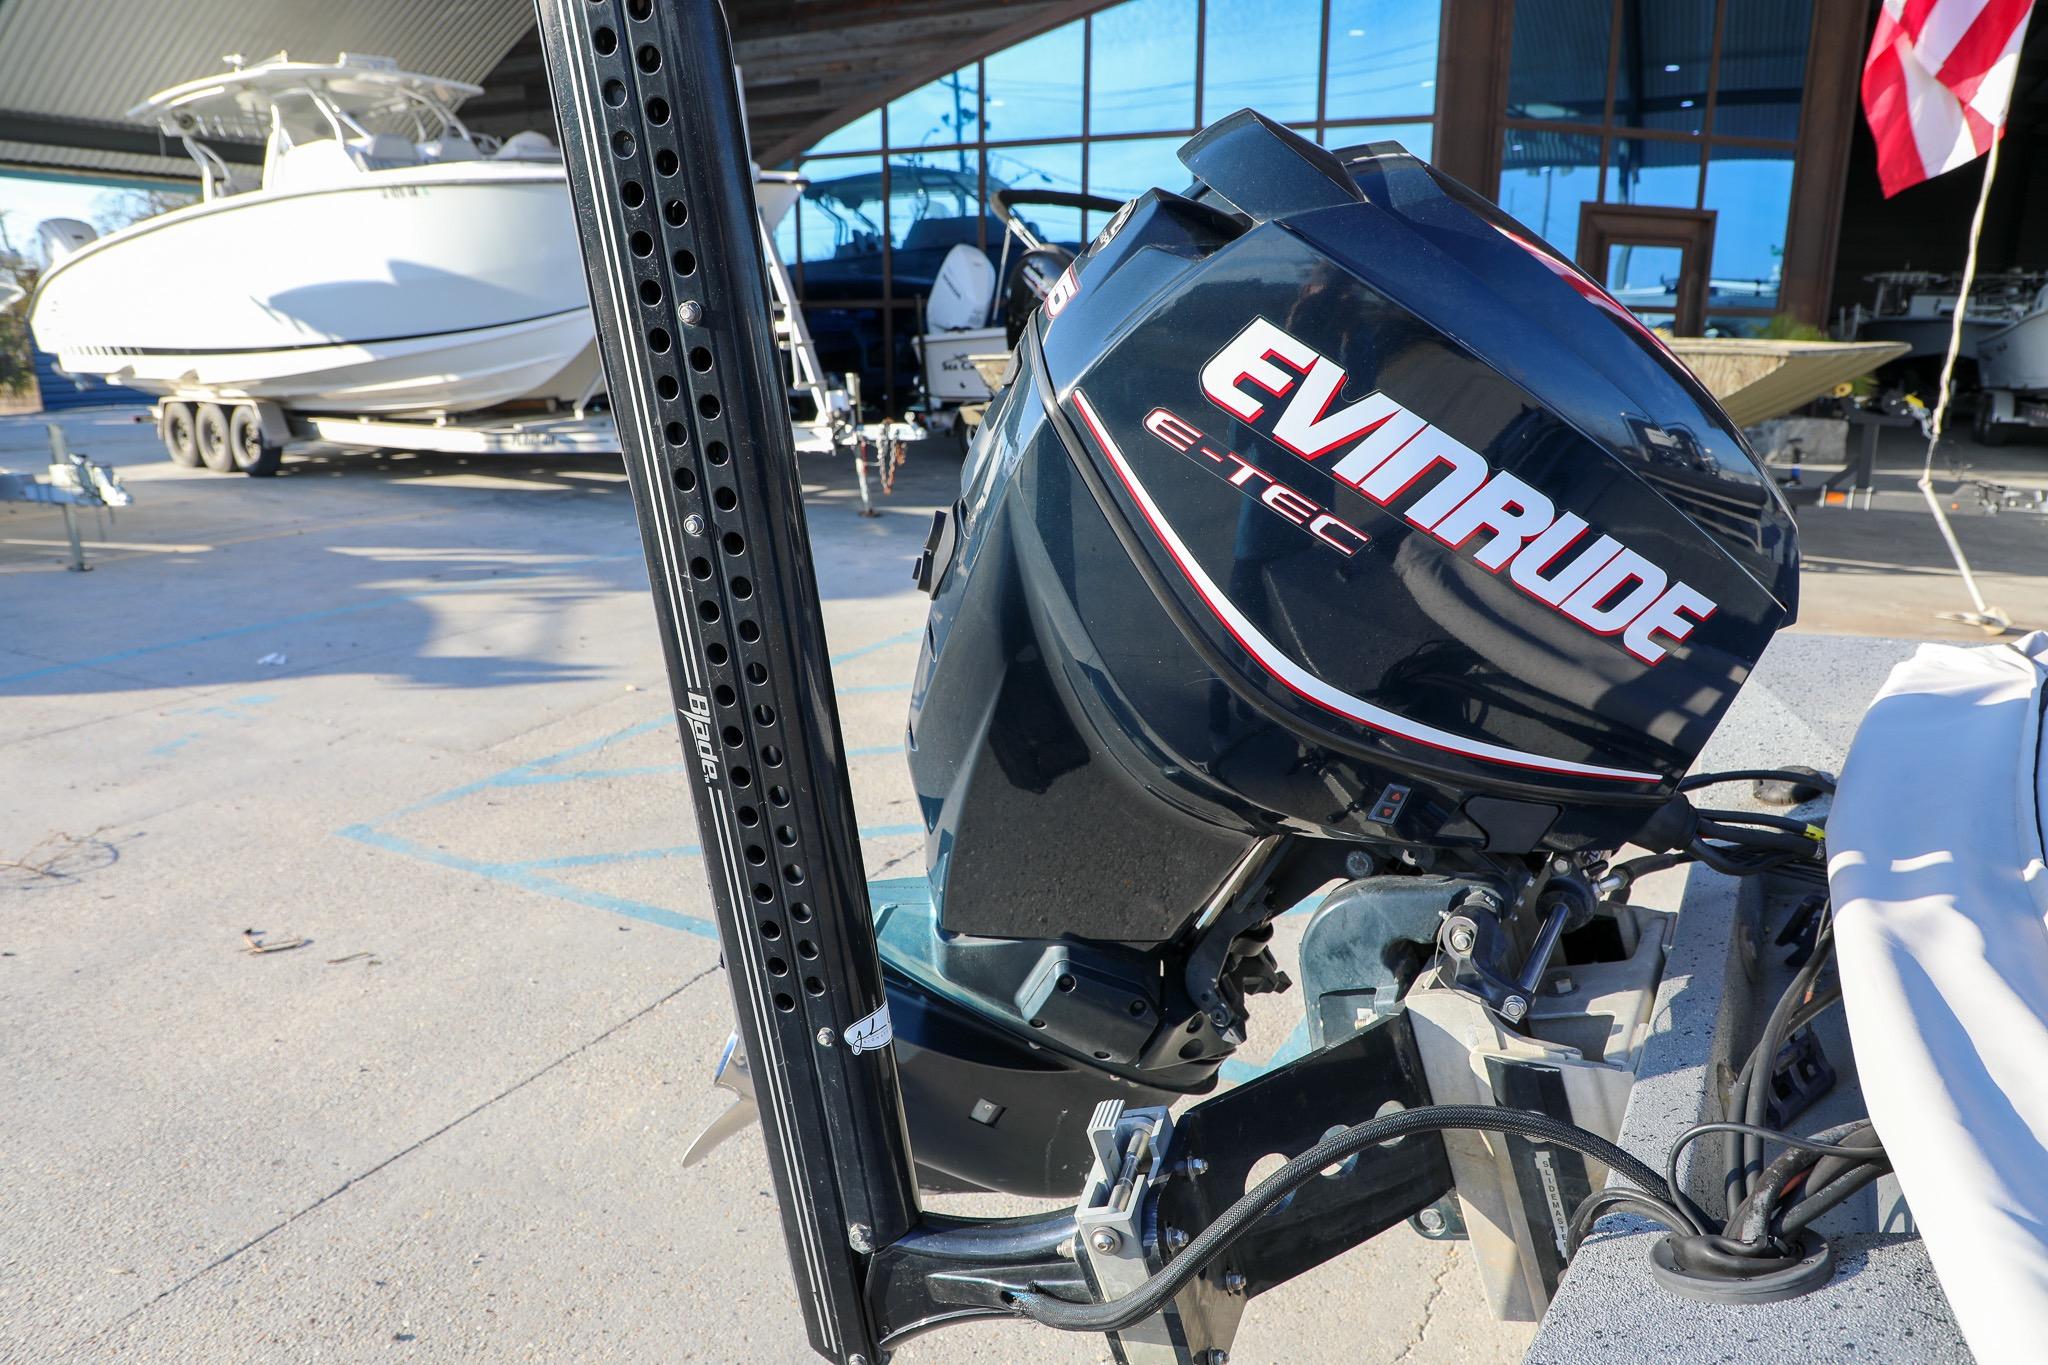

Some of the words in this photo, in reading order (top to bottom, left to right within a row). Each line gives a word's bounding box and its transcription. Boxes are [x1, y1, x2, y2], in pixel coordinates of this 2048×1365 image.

[1144, 408, 1371, 556] E-TEC
[1202, 318, 1718, 666] EVINRUDE
[678, 691, 719, 780] Blade
